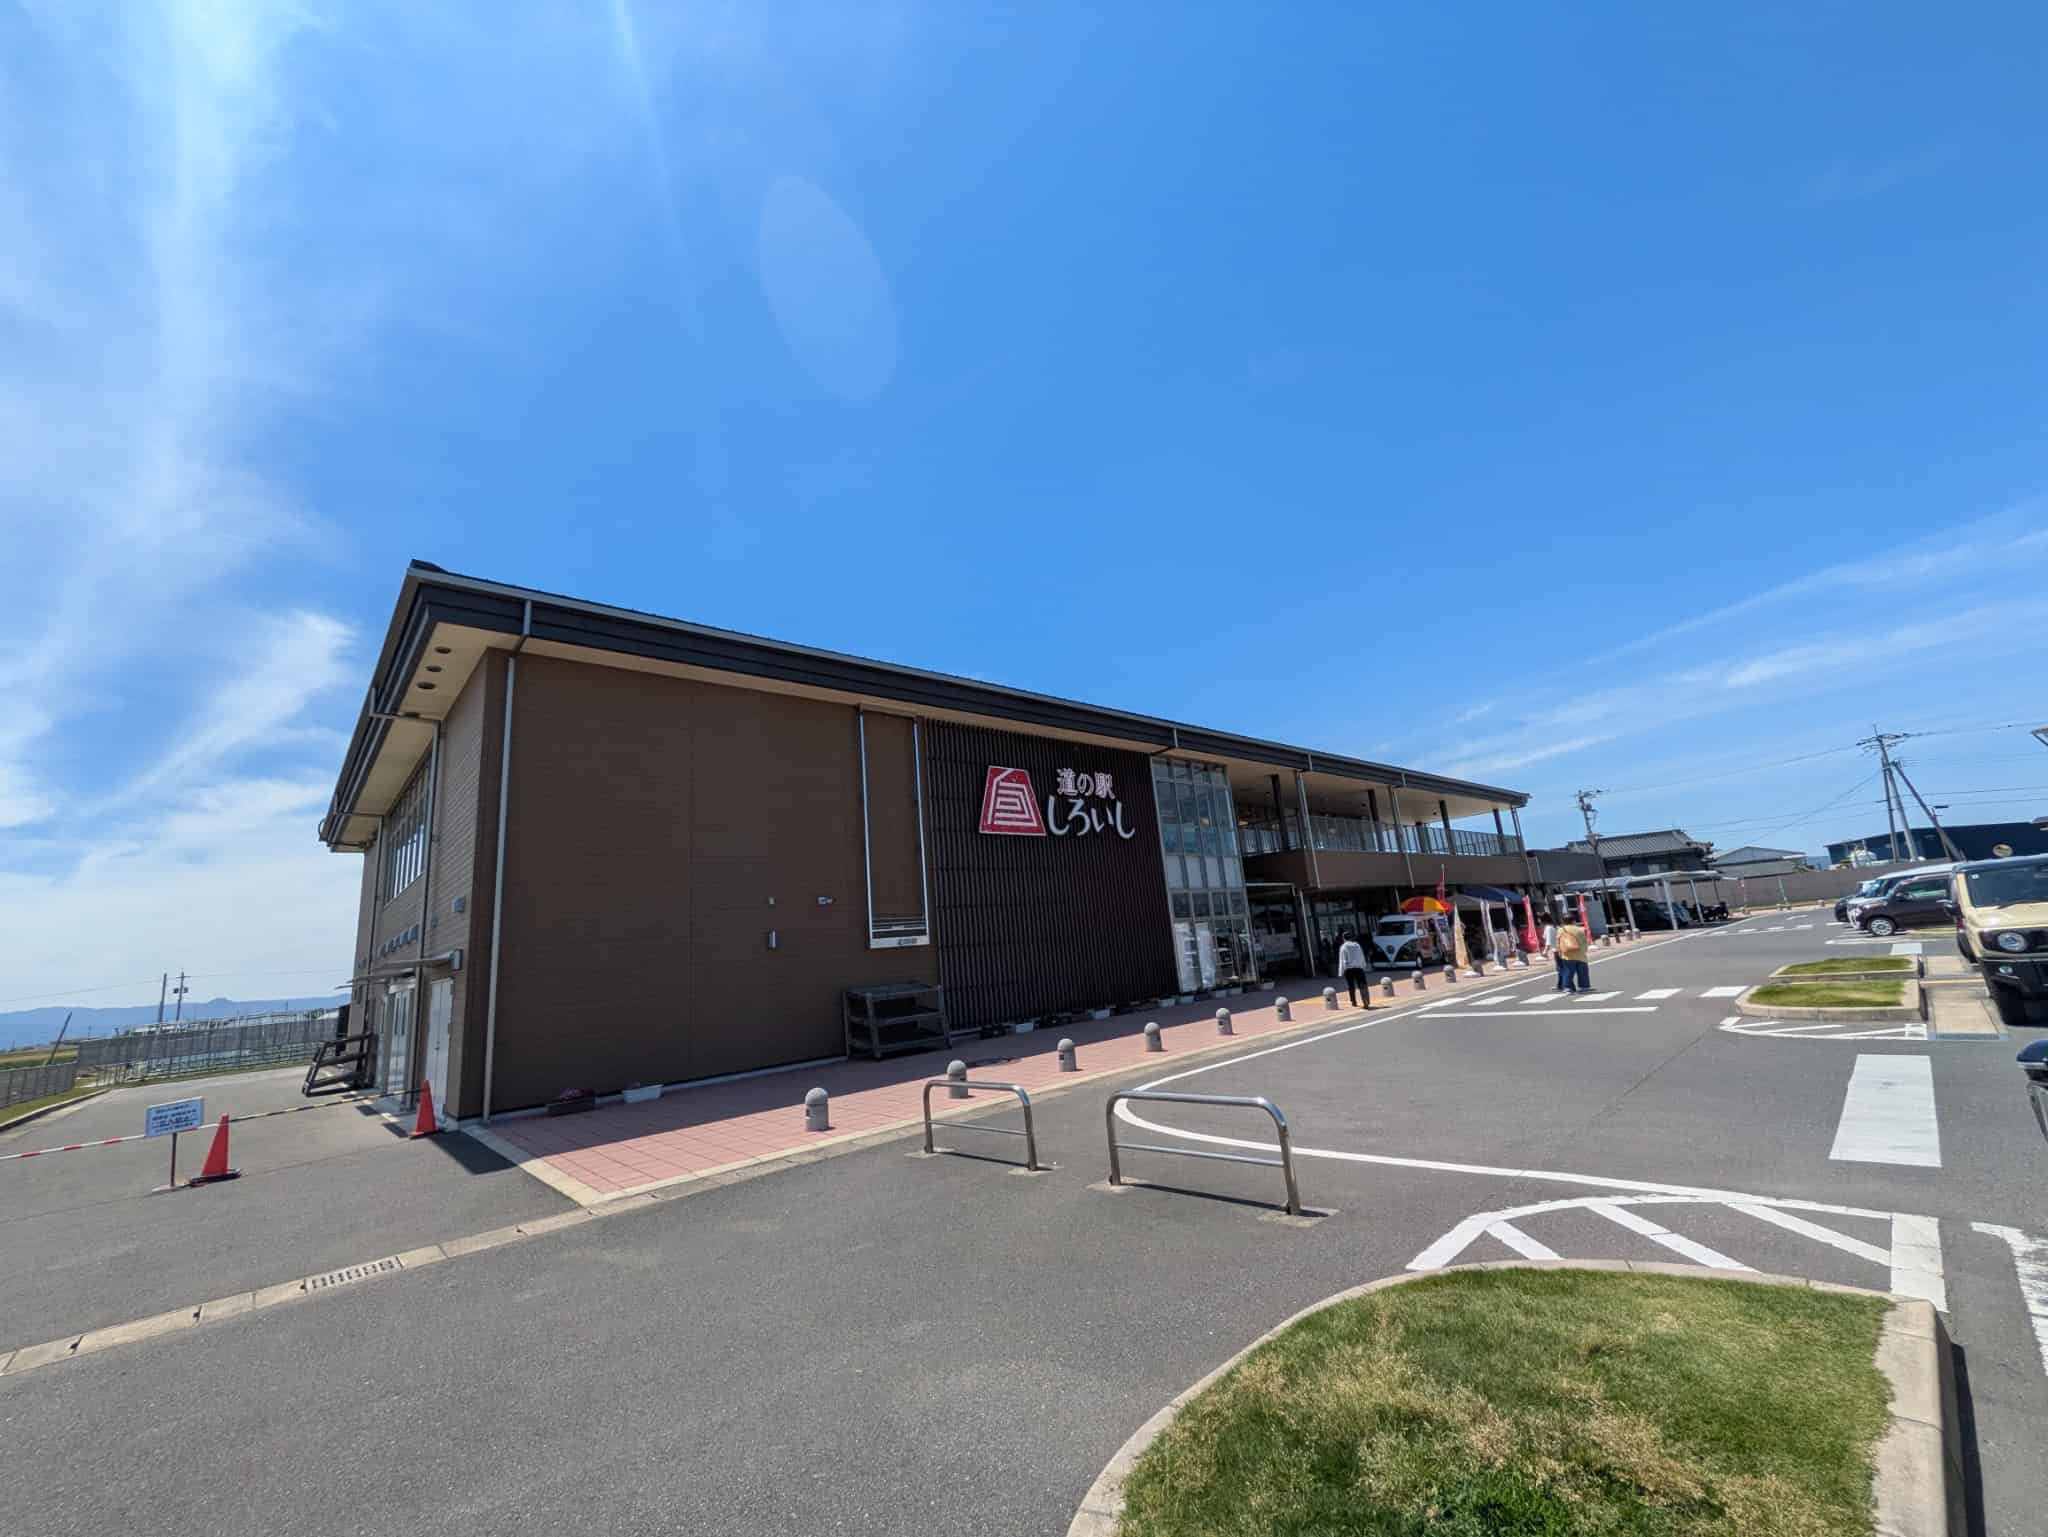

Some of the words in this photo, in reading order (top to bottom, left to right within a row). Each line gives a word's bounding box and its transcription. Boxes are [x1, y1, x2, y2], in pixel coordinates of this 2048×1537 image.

[1056, 768, 1115, 799] 道の駅
[1048, 795, 1135, 839] しろいし
